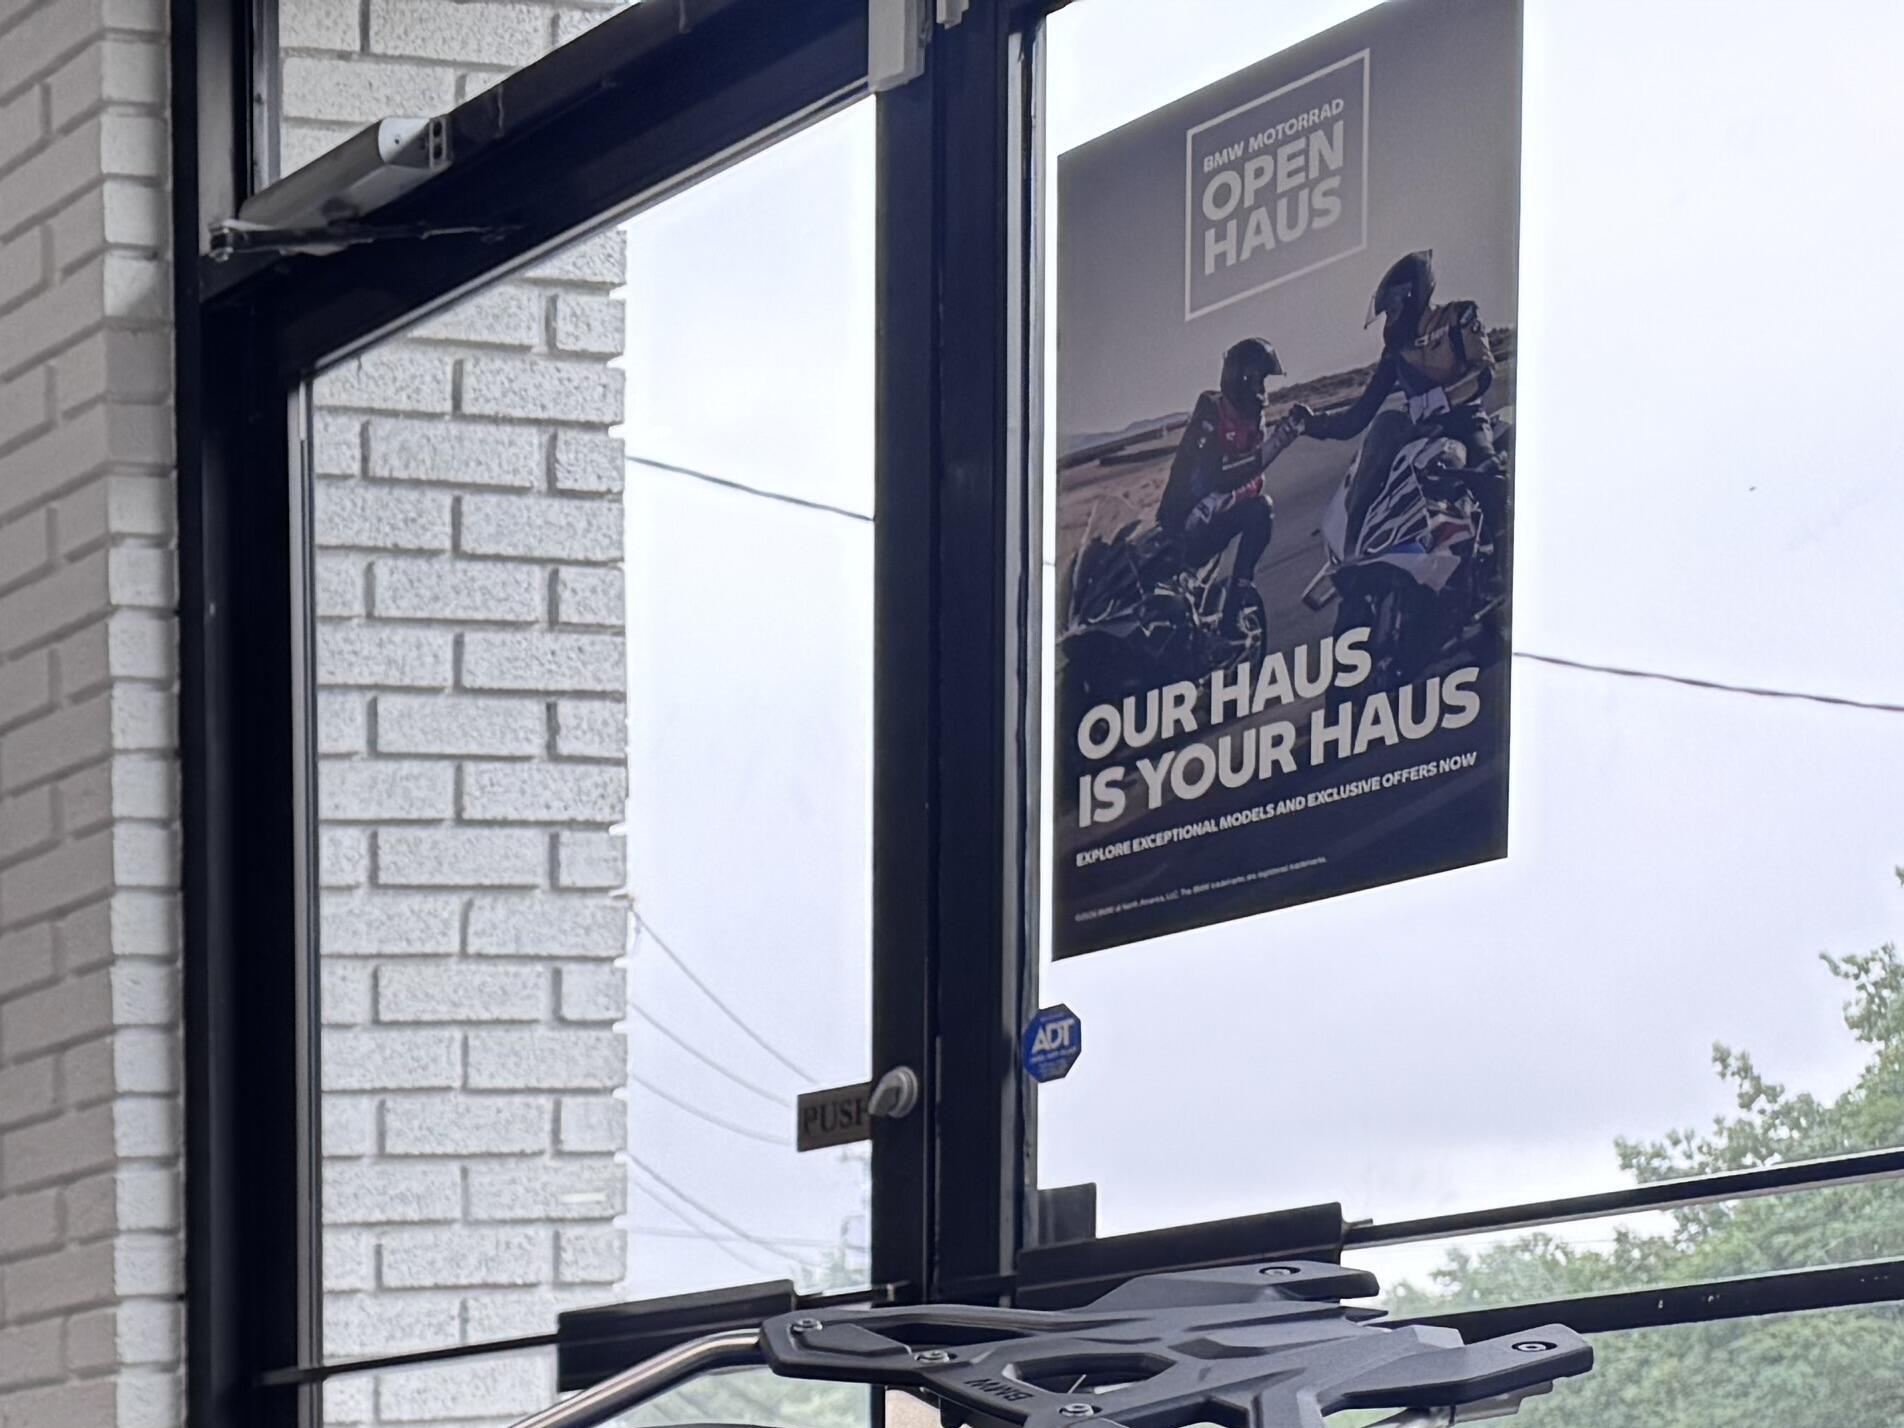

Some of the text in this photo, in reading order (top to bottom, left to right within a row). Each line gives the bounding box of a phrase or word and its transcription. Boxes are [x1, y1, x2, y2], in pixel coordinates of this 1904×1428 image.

[1202, 120, 1344, 221] OPEN
[1204, 98, 1344, 173] BMW MOTORRAD
[1204, 175, 1341, 276] HAUS
[1077, 626, 1372, 760] OUR HAUS
[1078, 666, 1481, 828] IS YOUR HAUS
[1075, 750, 1478, 868] EXPLORE EXCEPTIONAL MODELS AND EXCLUSIVE OFFERS NOW
[1032, 1018, 1075, 1054] ADT
[963, 1378, 1035, 1402] BMW
